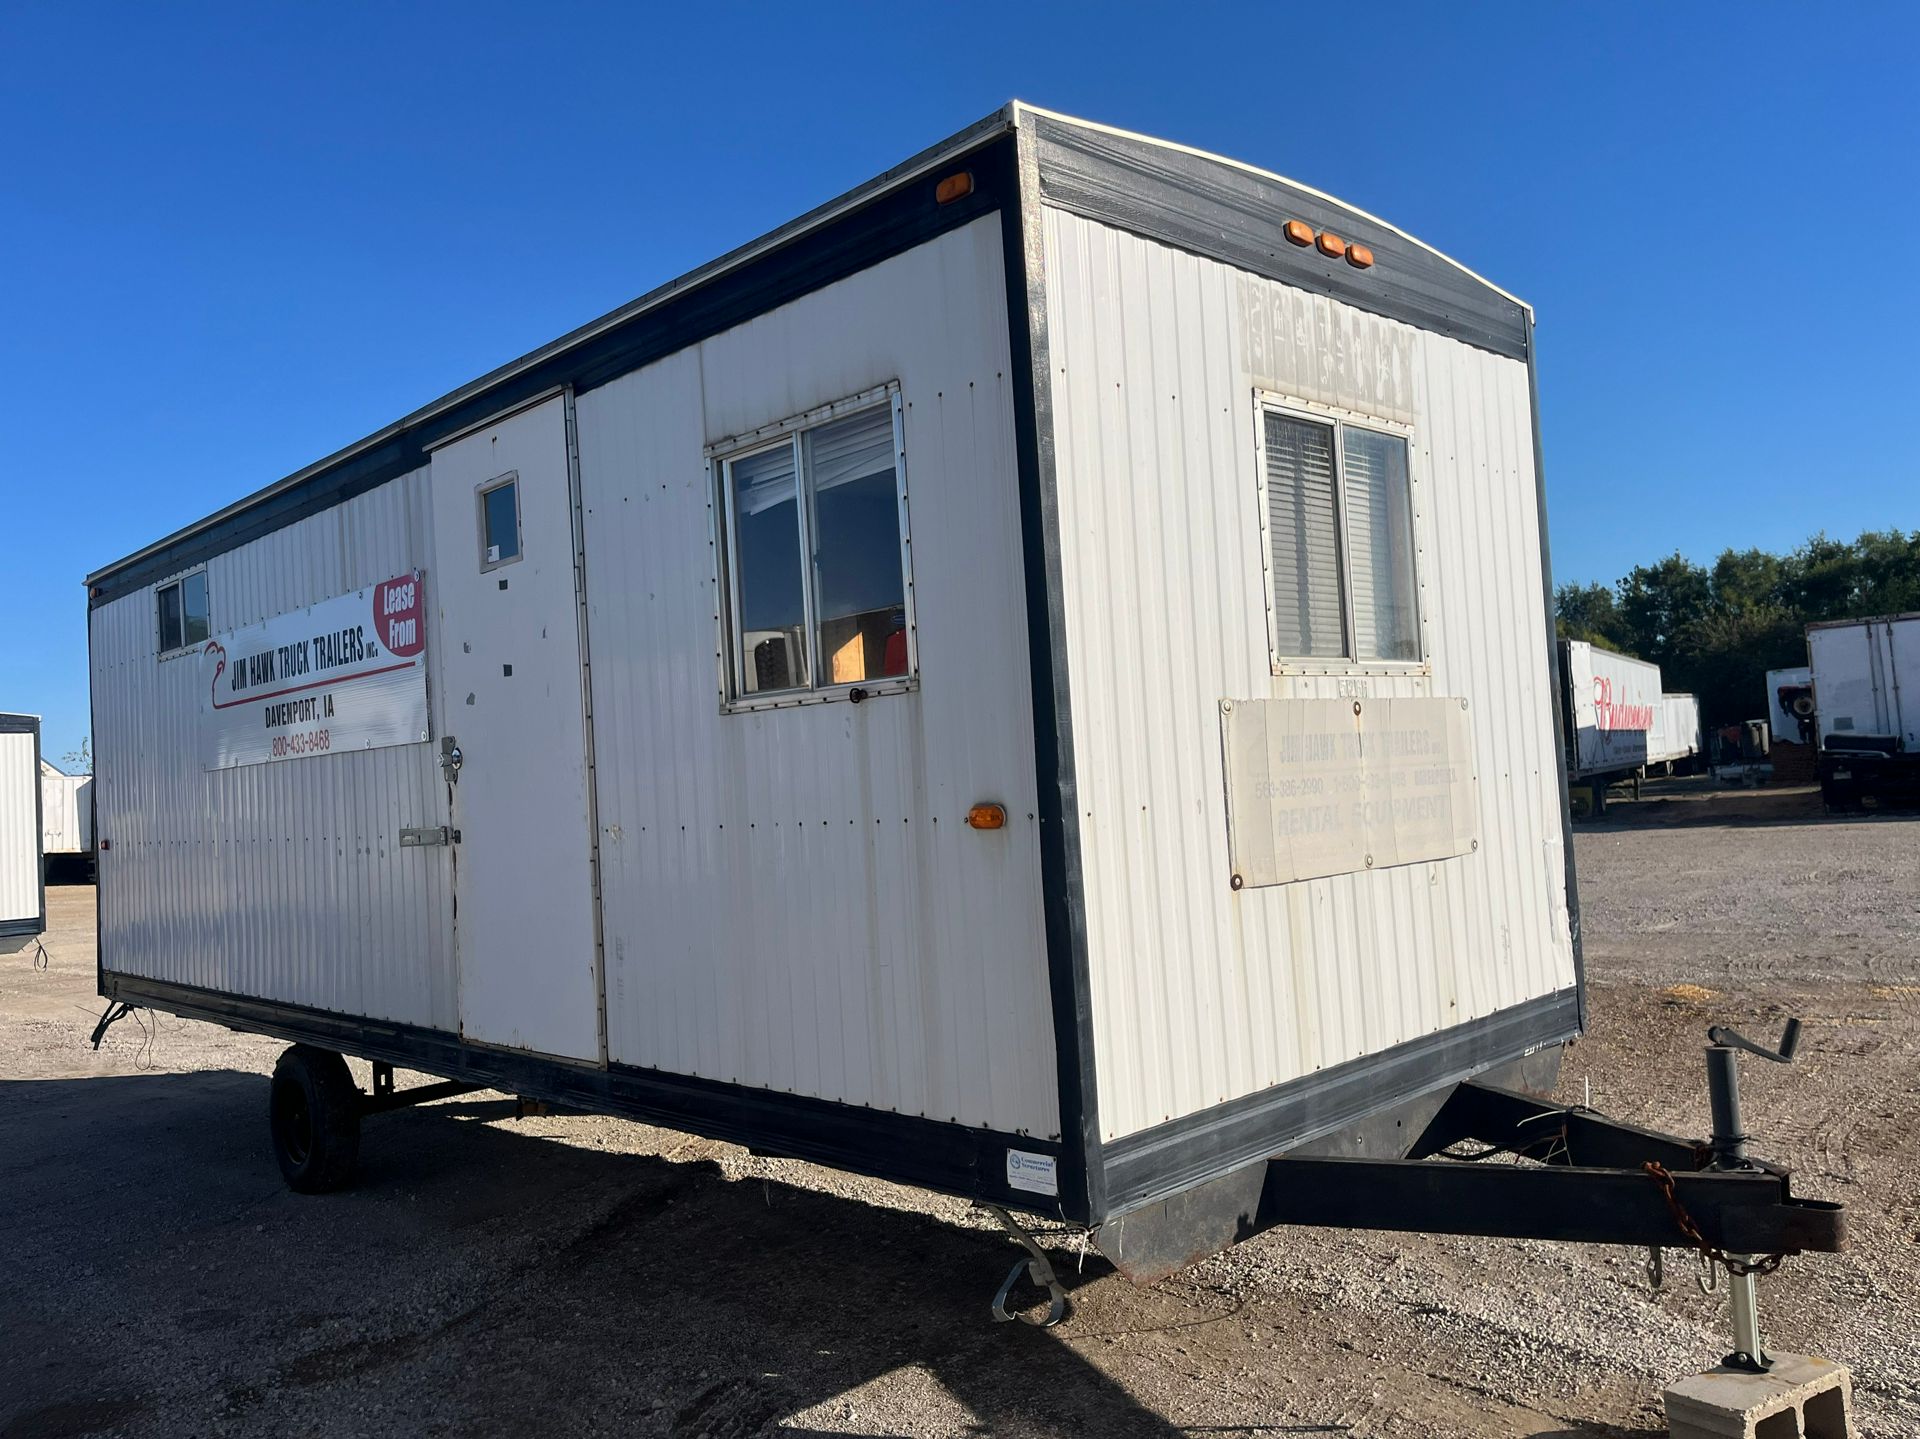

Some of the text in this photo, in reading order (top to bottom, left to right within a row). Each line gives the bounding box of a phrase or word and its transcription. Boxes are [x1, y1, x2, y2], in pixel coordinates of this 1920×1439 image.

[384, 582, 415, 616] Lease
[389, 618, 416, 650] From
[232, 658, 247, 692] JIM
[250, 651, 276, 687] HAWK
[278, 640, 309, 680] TRUCK
[313, 625, 364, 670] TRAILERS
[265, 694, 335, 729] DAVENPORT, IA
[272, 729, 330, 757] 800-433-8468
[1279, 804, 1344, 837] RENTAL
